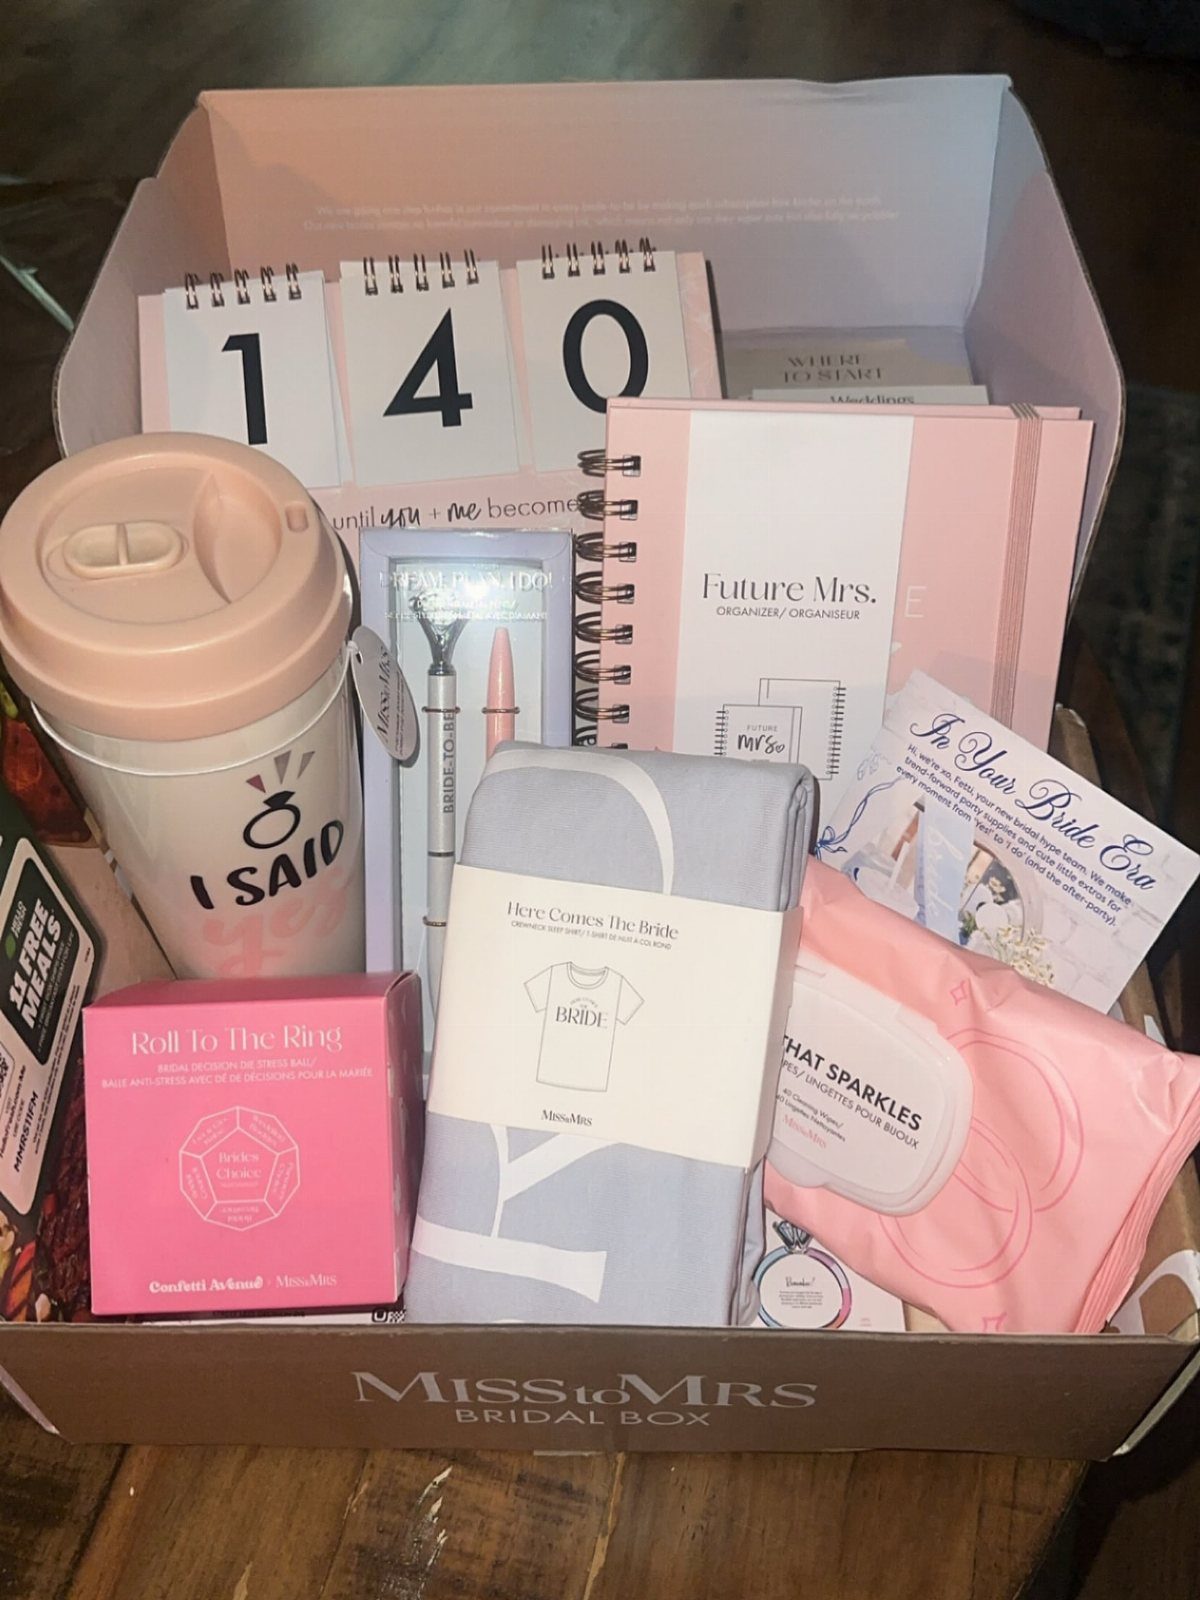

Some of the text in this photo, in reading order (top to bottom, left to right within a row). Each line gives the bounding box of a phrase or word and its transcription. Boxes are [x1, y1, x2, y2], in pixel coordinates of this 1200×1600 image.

[222, 299, 649, 445] 1 4 0
[784, 368, 882, 383] TO START
[787, 354, 862, 367] WHERE
[333, 507, 375, 530] until
[381, 506, 421, 528] you
[448, 502, 481, 522] me
[488, 497, 579, 518] become
[702, 573, 877, 604] Future Mrs.
[716, 606, 860, 620] ORGANIZER/ ORGANISEUR
[443, 708, 455, 814] BRIDE-TO-BE
[910, 713, 1156, 890] In Your Bride Era
[896, 766, 919, 784] every
[918, 781, 952, 808] moment
[952, 803, 972, 822] from
[994, 833, 1006, 845] to
[1025, 856, 1047, 874] (and
[1046, 870, 1062, 886] the
[904, 756, 1122, 913] trend-forward party supplies and cute little extras for
[976, 791, 996, 809] your
[995, 805, 1014, 821] new
[1013, 816, 1040, 841] bridal
[1040, 835, 1062, 856] hype
[1062, 851, 1088, 875] team.
[1090, 870, 1105, 887] We
[1105, 883, 1132, 906] make
[190, 820, 344, 910] I SAID
[507, 901, 679, 940] Here Comes The Bride
[511, 920, 546, 931] CREWNECK
[9, 898, 49, 1013] 11 FREE
[556, 1006, 608, 1029] BRIDE
[131, 1024, 343, 1055] Roll To The Ring
[102, 1078, 127, 1088] BALLE
[130, 1076, 186, 1087] ANTI-STRESS
[189, 1075, 212, 1085] AVEC
[229, 1073, 241, 1083] DE
[298, 1069, 324, 1080] POUR
[326, 1069, 337, 1079] LA
[158, 1063, 188, 1073] BRIDAL
[192, 1061, 237, 1072] DECISION
[257, 1058, 289, 1069] STRESS
[783, 1060, 919, 1150] PES/ LINGETTES POUR BIJOUX
[826, 1063, 922, 1131] SPARKLES
[215, 1167, 262, 1179] Choice
[218, 1152, 260, 1164] Brides
[149, 1280, 206, 1294] Confetti
[455, 1408, 711, 1426] BRIDAL BOX
